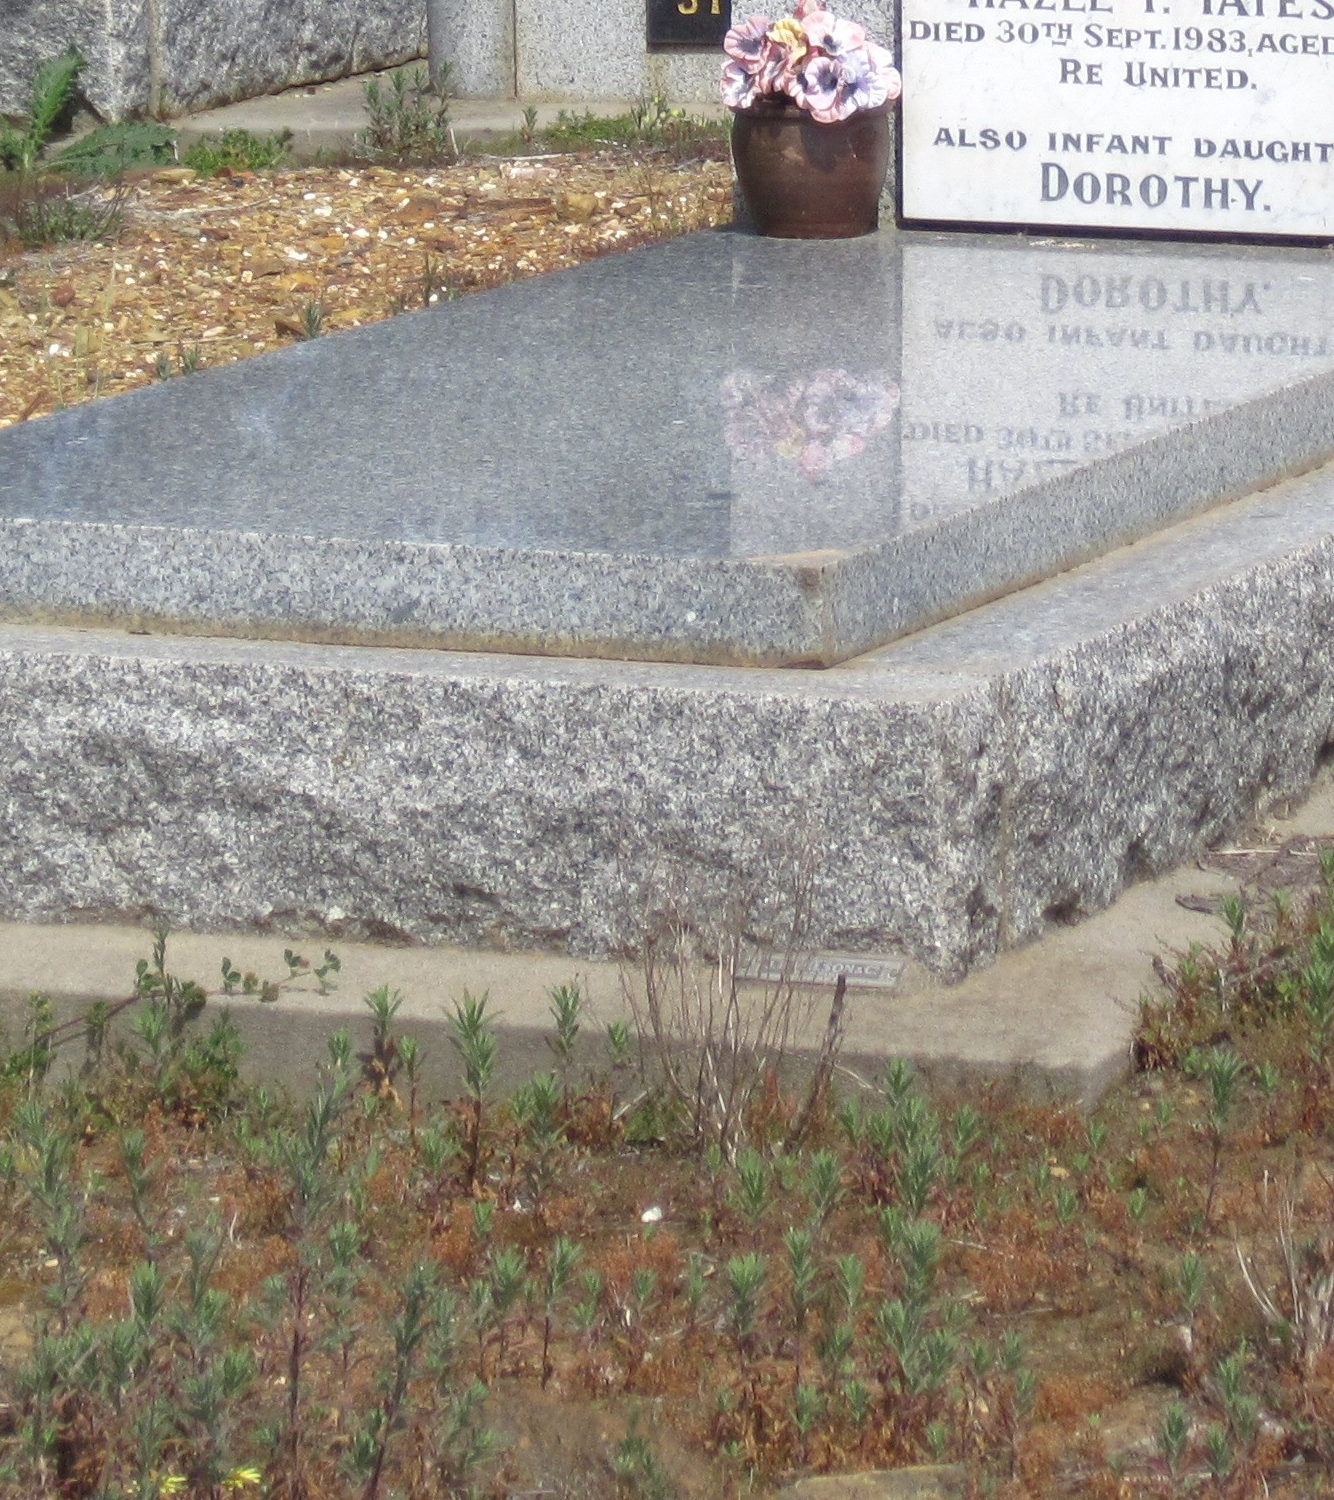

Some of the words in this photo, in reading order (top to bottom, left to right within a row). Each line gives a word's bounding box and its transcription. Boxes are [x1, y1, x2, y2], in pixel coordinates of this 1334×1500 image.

[909, 21, 985, 43] DIED
[996, 21, 1073, 46] 30TH
[1084, 24, 1166, 49] SEPT.
[1060, 58, 1103, 86] RE
[1125, 62, 1257, 89] UNITED.
[933, 127, 1027, 150] ALSO
[1048, 132, 1173, 155] INFANT
[1040, 163, 1271, 211] DOROTHY.
